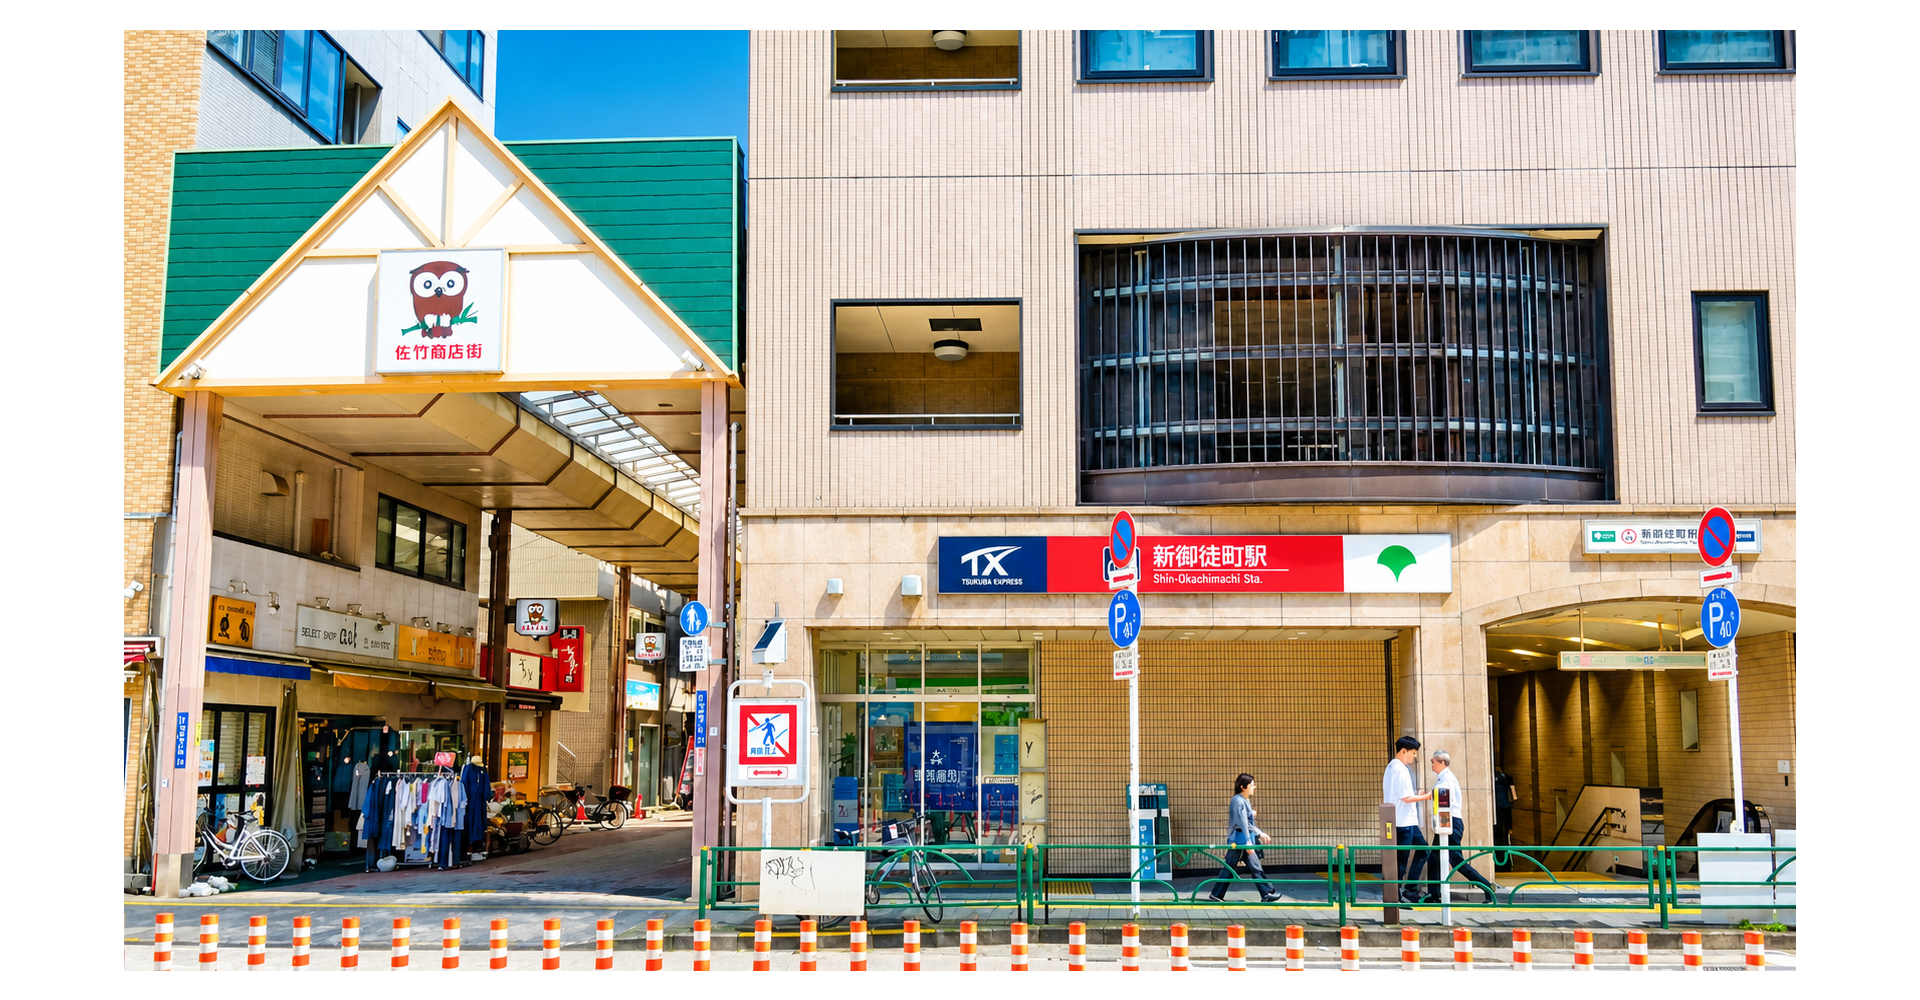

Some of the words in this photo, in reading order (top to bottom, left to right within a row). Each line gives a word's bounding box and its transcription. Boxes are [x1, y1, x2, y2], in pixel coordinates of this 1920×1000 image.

[395, 343, 482, 360] 佐竹商店街
[961, 546, 1022, 576] TX
[1153, 544, 1267, 568] 新御徒町駅
[962, 578, 992, 586] TSUKUBA
[993, 578, 1023, 586] EXPRESS
[1244, 574, 1263, 584] Sta.
[1115, 603, 1126, 639] P
[1709, 602, 1724, 639] P
